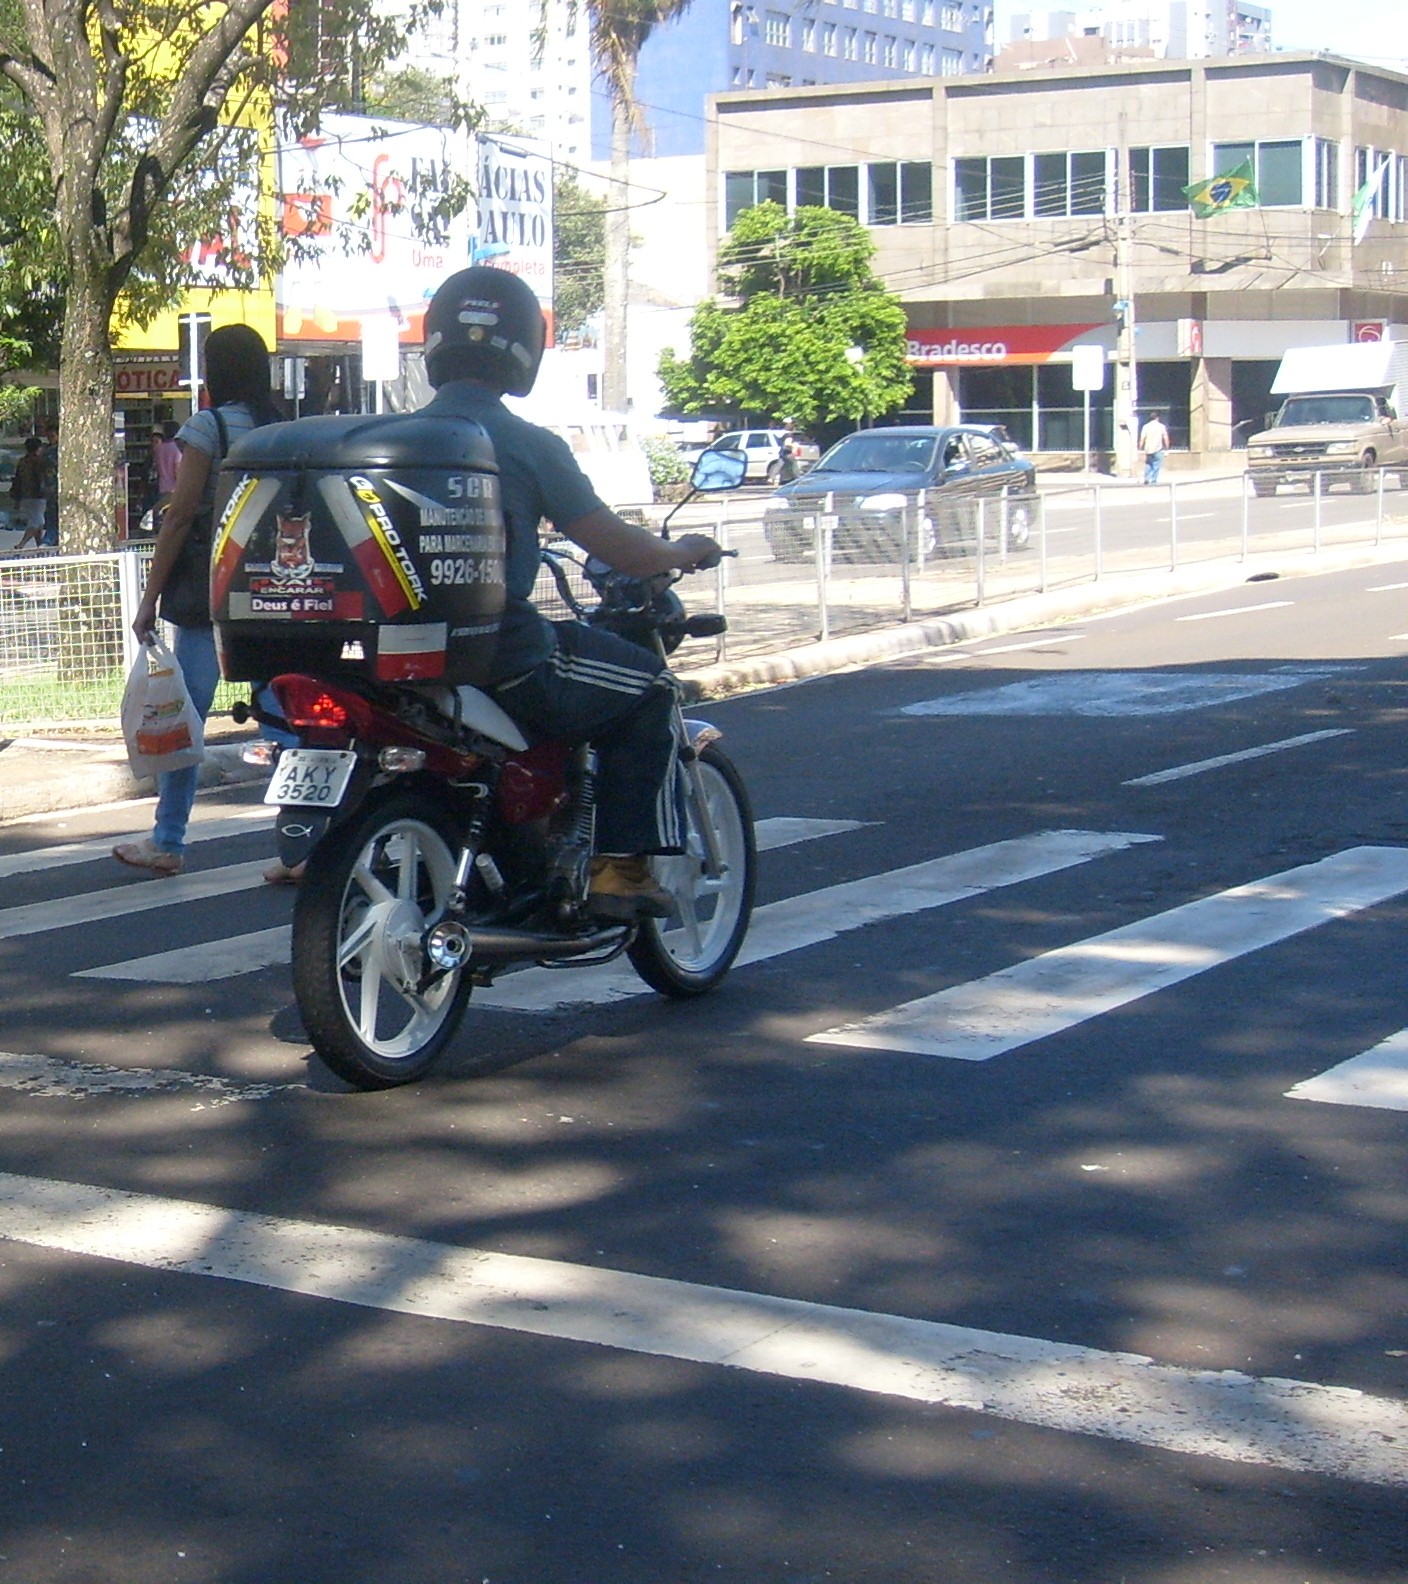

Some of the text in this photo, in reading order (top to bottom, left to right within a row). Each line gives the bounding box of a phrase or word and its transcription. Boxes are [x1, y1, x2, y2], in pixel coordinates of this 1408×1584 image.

[906, 339, 1007, 361] Bradesco
[220, 473, 252, 525] TORK
[369, 503, 401, 546] PRO
[395, 546, 428, 603] TORK
[419, 534, 443, 554] PARA
[252, 598, 333, 611] Deus é Fiel
[285, 765, 337, 783] AKY
[276, 783, 331, 801] 3520
